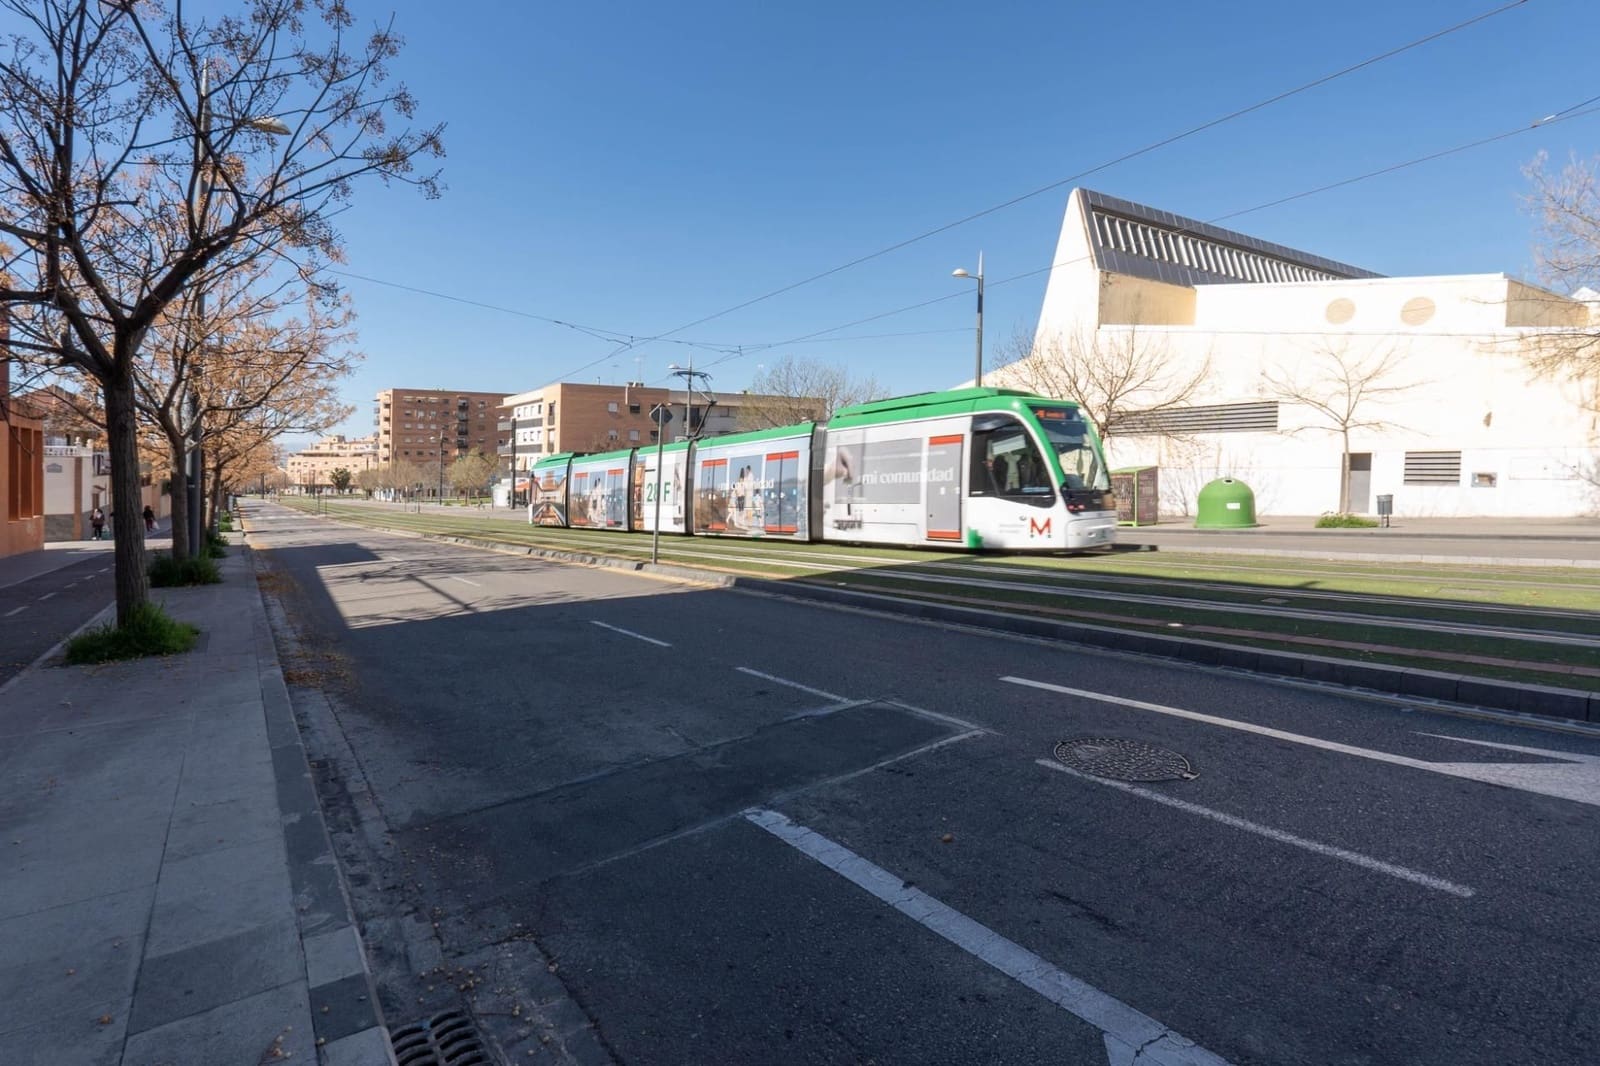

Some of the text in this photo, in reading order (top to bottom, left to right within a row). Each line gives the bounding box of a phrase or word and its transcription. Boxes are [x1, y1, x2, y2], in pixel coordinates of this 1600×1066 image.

[862, 467, 954, 484] mi comunidad
[663, 482, 672, 503] F
[1029, 516, 1052, 538] M
